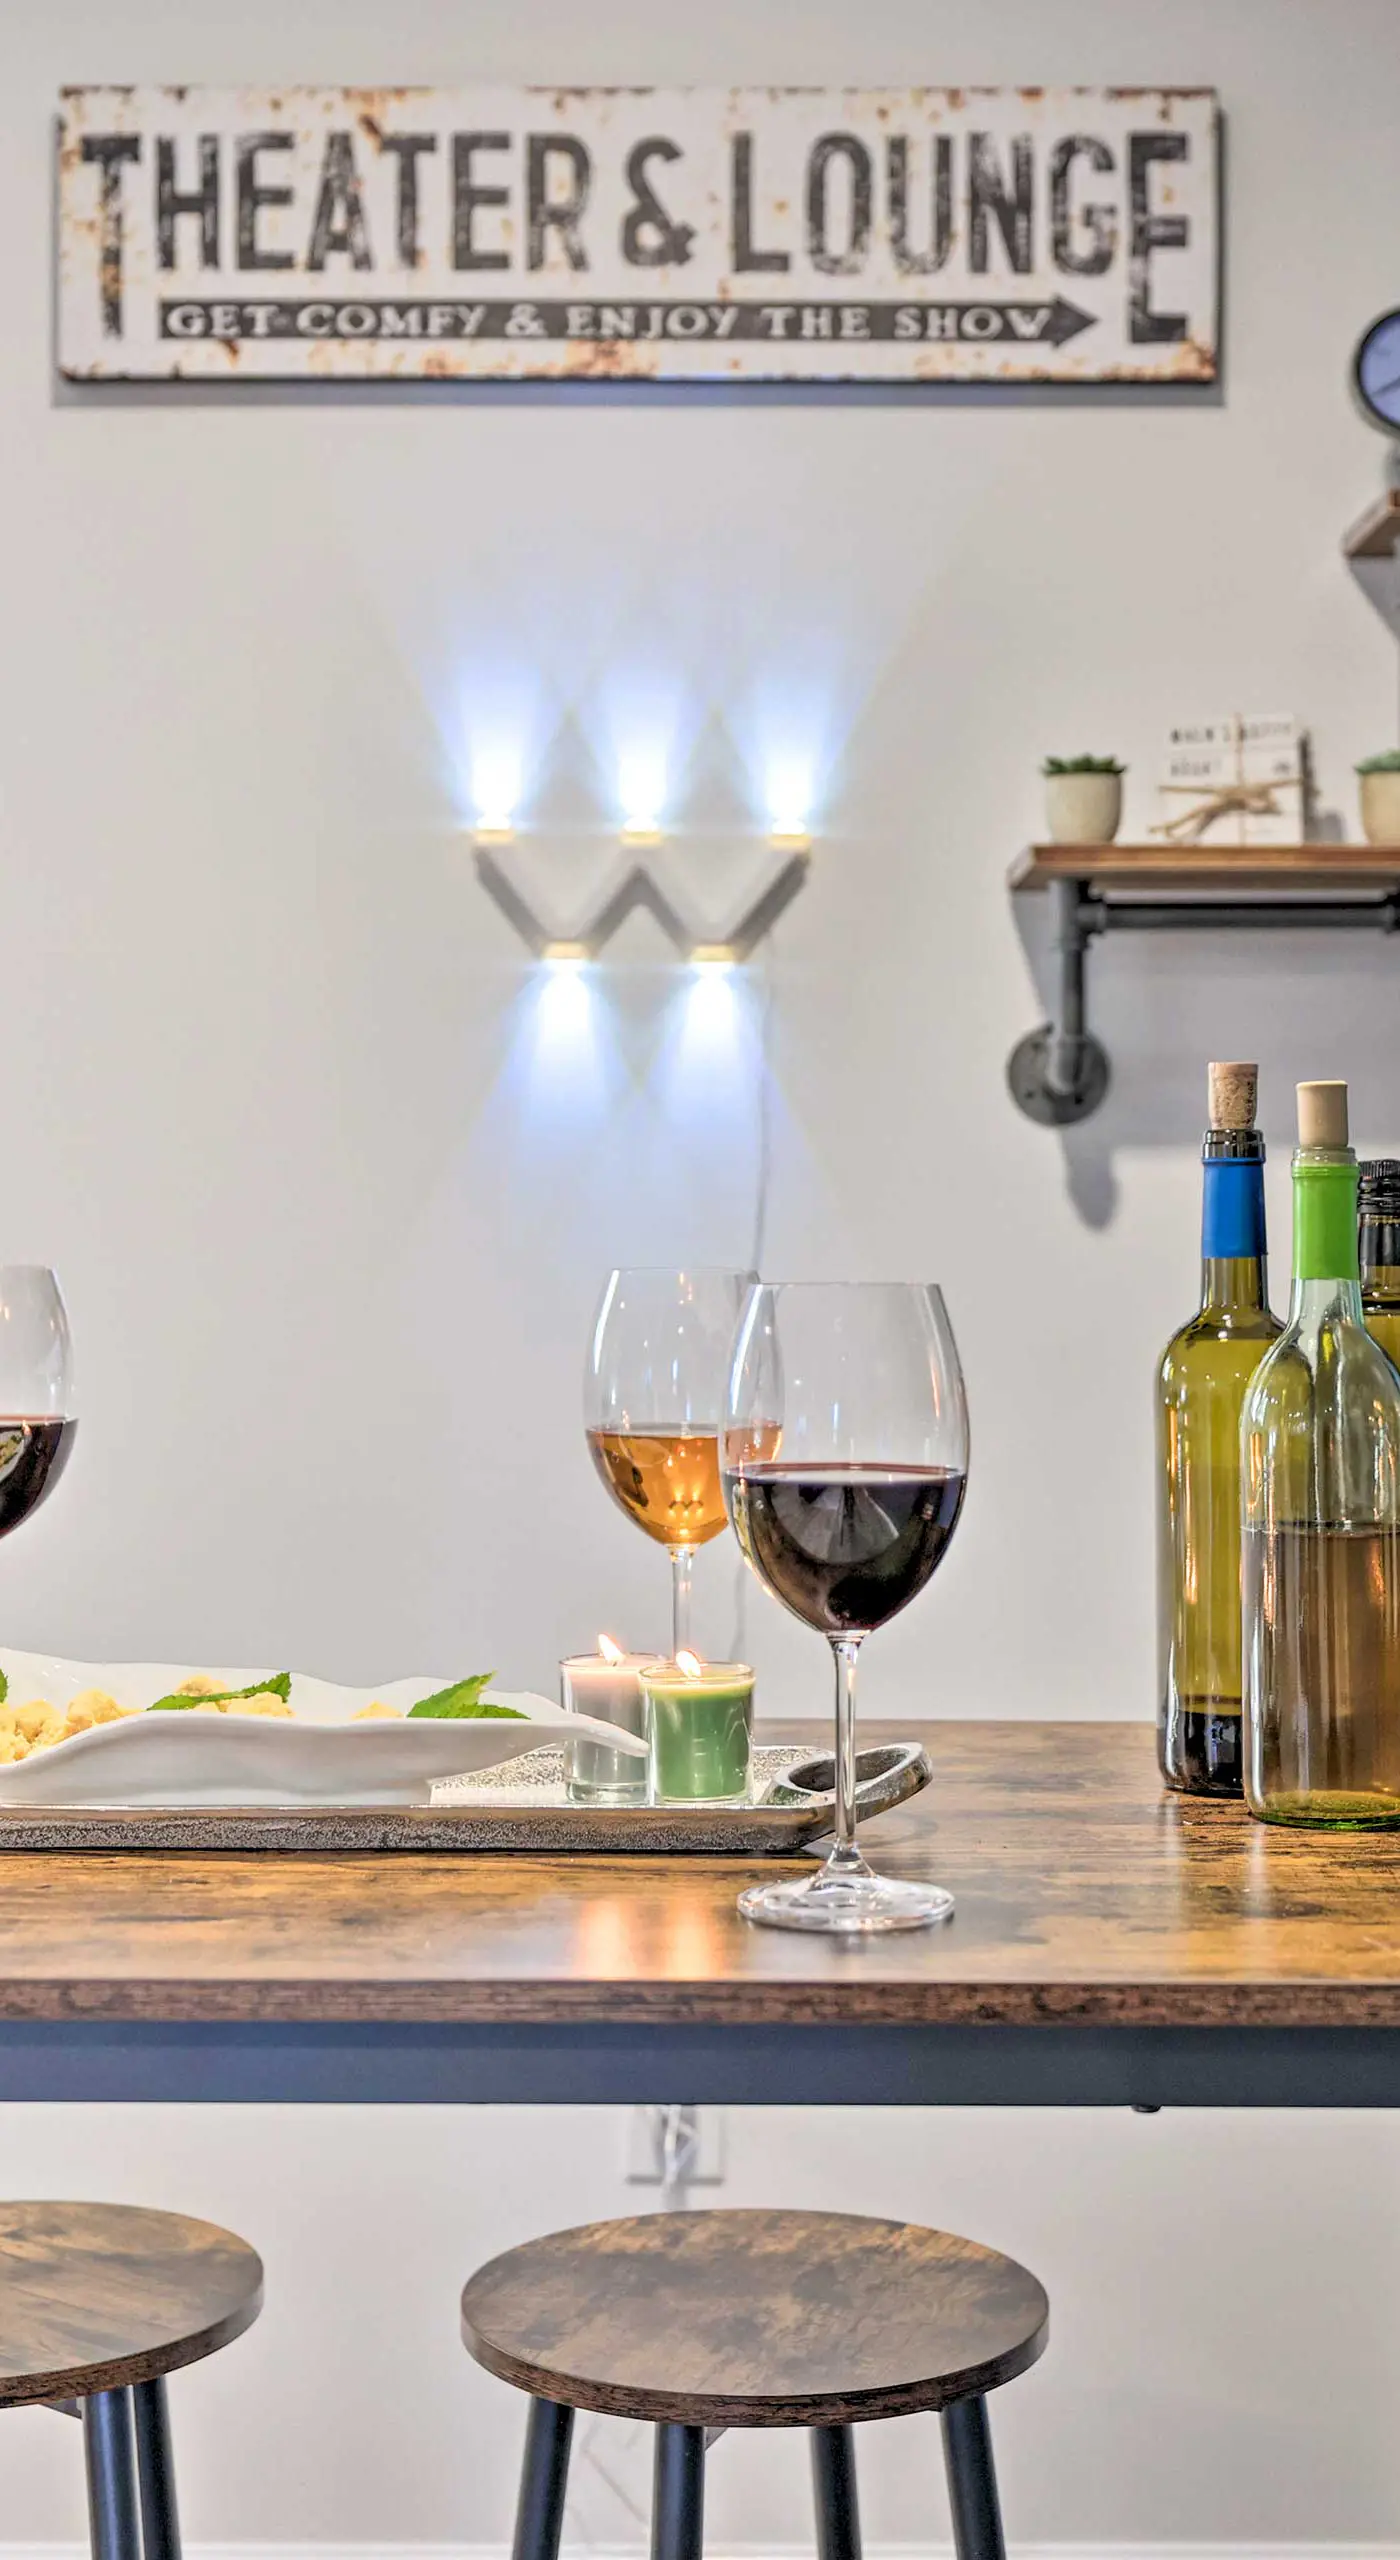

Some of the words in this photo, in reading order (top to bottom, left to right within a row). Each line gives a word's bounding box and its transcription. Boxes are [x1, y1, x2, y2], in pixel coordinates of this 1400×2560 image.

[81, 131, 591, 338] THEATER
[620, 134, 696, 267] &
[731, 130, 1189, 344] LOUNGE
[167, 304, 280, 337] GET
[300, 304, 487, 337] COMFY
[505, 304, 546, 337] &
[566, 305, 739, 338] ENJOY
[768, 306, 871, 338] THE
[893, 306, 1053, 338] SHOW
